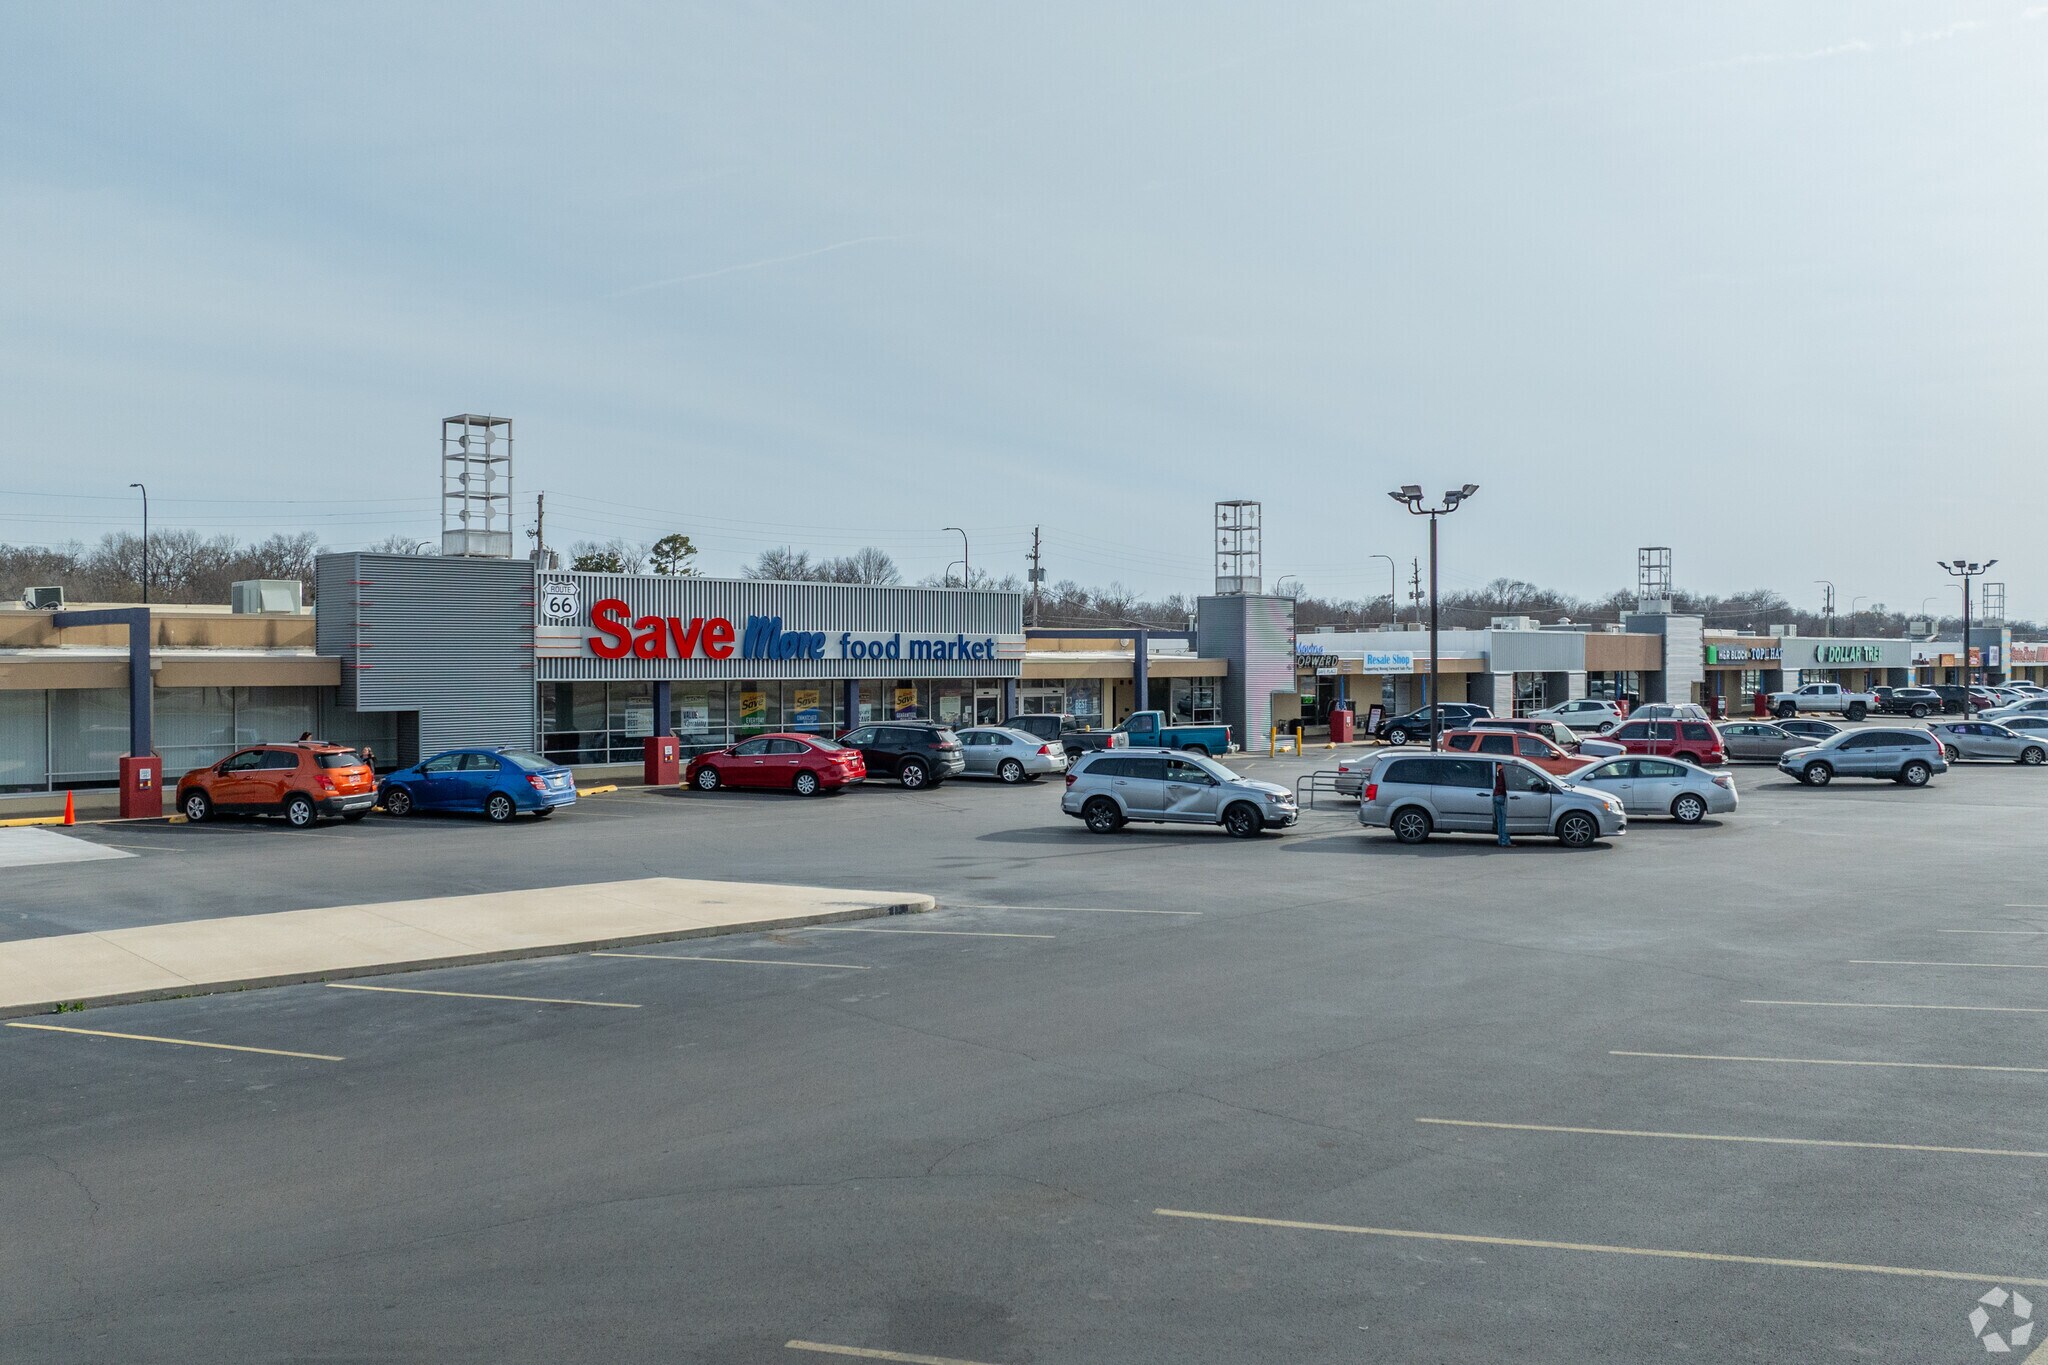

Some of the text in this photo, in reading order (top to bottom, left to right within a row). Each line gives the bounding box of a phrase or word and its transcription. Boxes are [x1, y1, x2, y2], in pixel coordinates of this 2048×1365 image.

[550, 597, 572, 613] 66
[588, 598, 995, 660] Save More food market
[1367, 654, 1409, 666] Resale Shop
[1731, 650, 1748, 660] BLOCK
[1751, 648, 1765, 660] TOP
[1828, 645, 1882, 662] DOLLAR TREE
[1297, 655, 1339, 668] ORWARD
[742, 697, 764, 710] Save
[797, 696, 817, 707] Save
